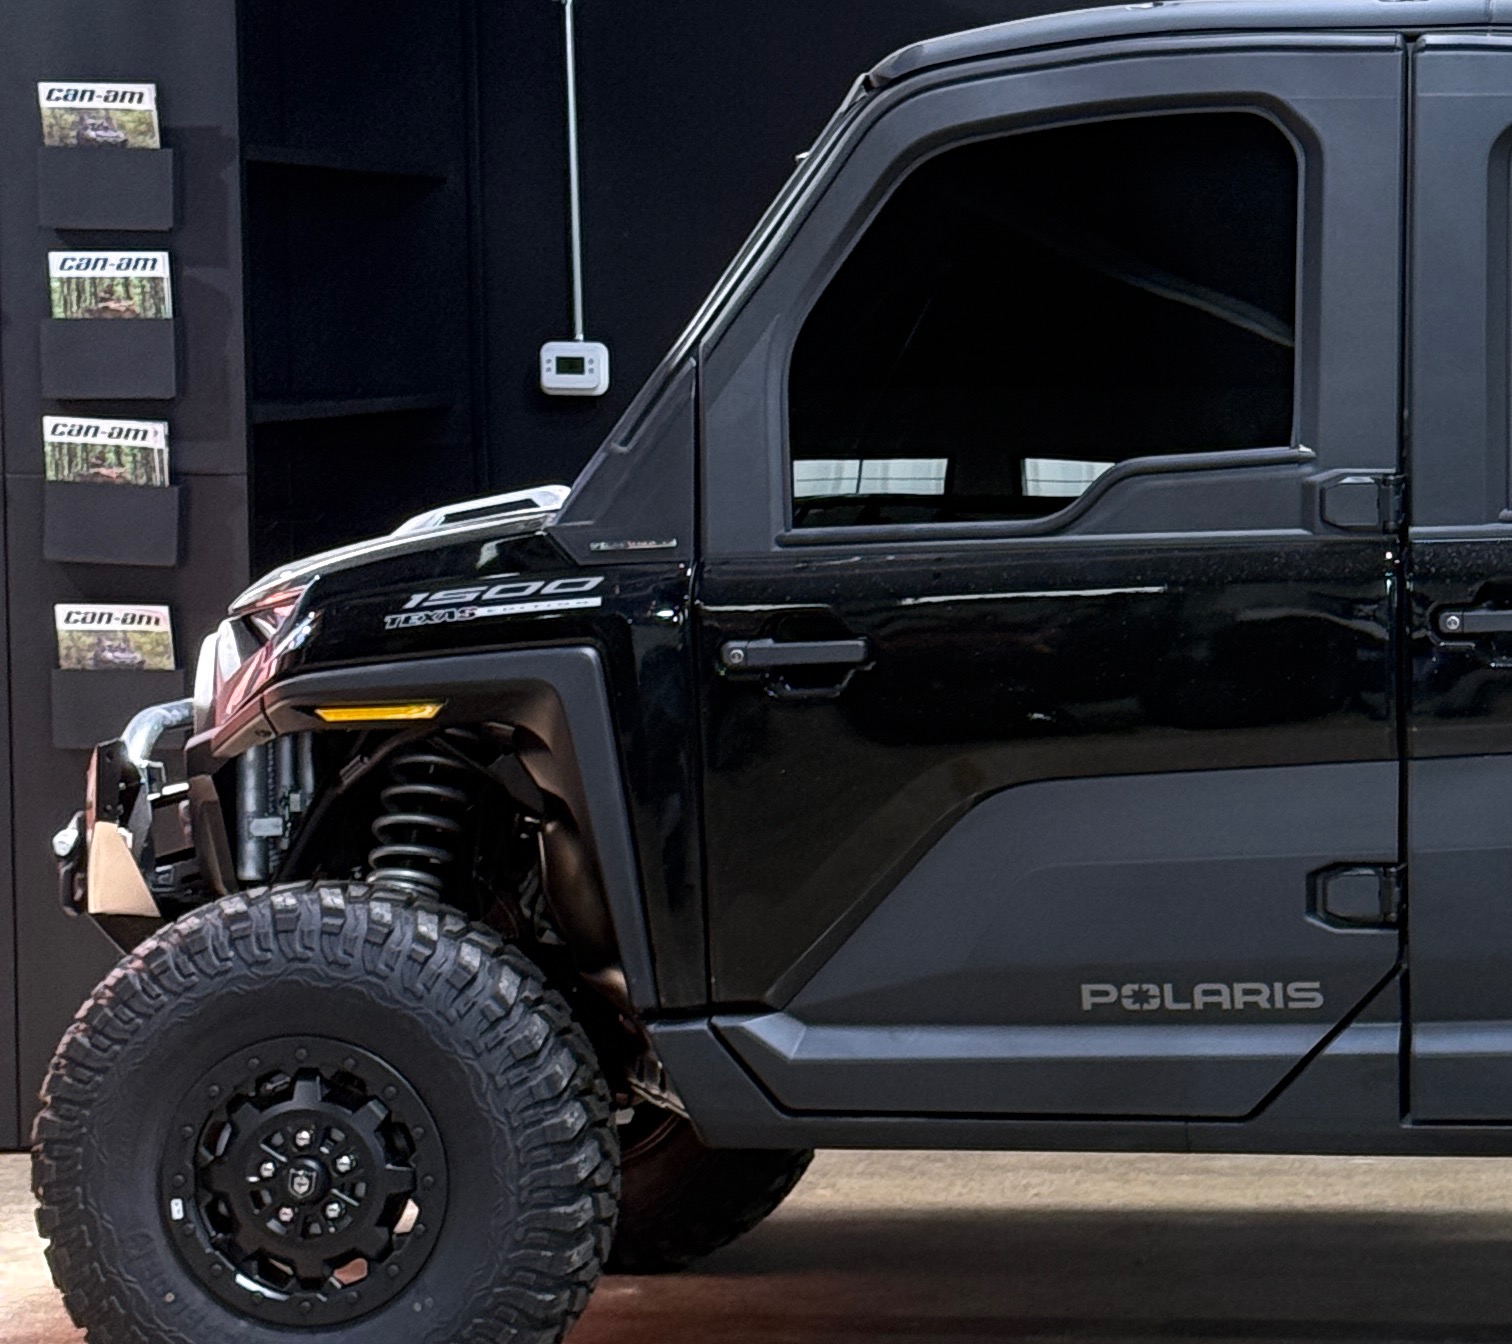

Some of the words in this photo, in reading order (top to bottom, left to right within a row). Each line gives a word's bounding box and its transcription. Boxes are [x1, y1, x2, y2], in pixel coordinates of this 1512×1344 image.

[46, 87, 145, 105] can-am
[58, 257, 158, 272] can-am
[50, 423, 149, 442] can-am
[402, 576, 605, 609] 1500
[63, 611, 161, 627] can-am
[385, 606, 479, 630] TEXAS
[1081, 981, 1325, 1011] POLARIS
